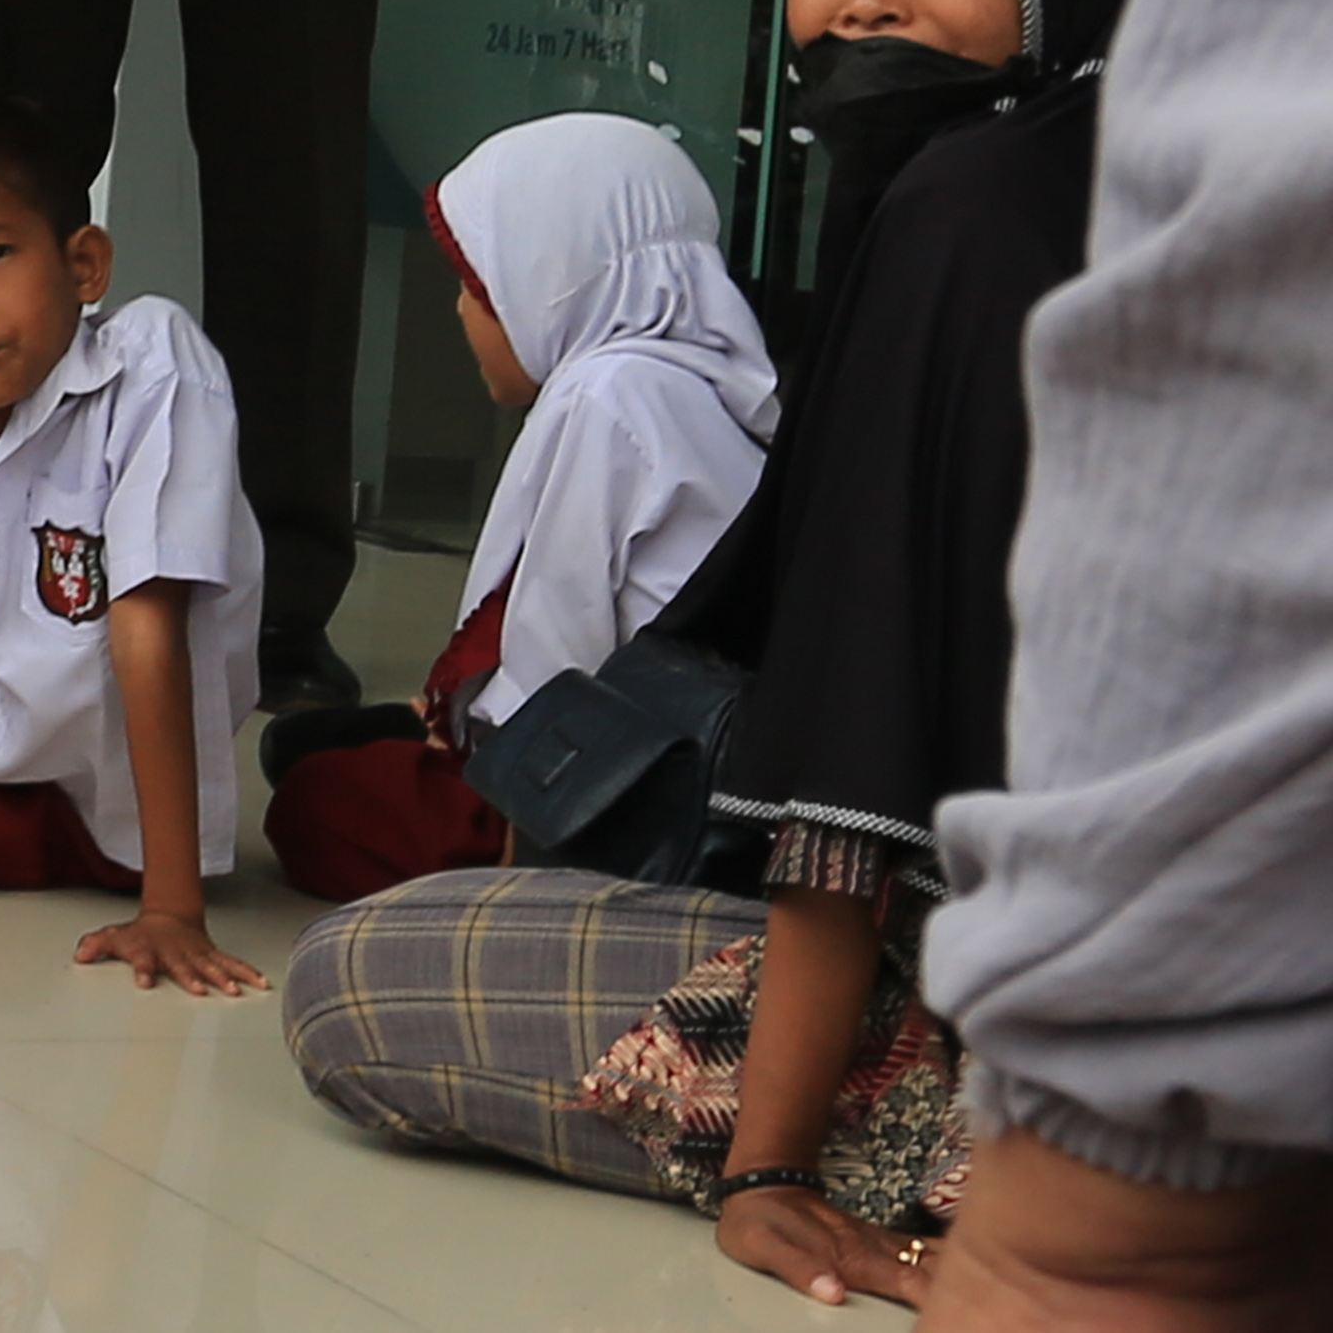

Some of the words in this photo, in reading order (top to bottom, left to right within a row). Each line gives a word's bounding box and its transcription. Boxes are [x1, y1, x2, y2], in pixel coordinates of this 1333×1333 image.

[485, 22, 510, 54] 24
[515, 24, 556, 57] Jam
[563, 28, 576, 59] 7
